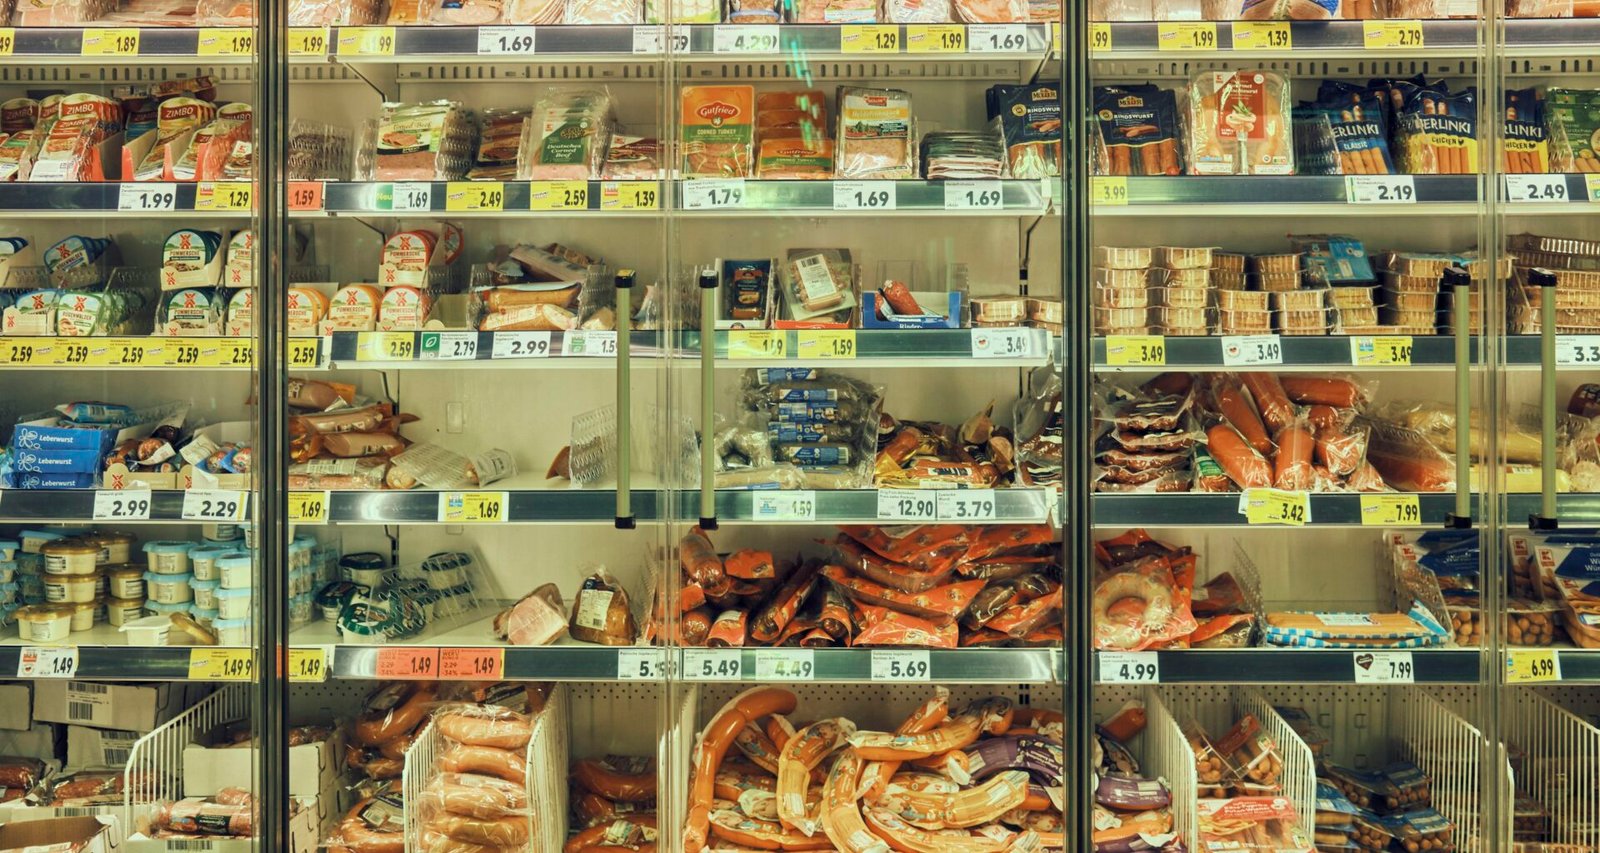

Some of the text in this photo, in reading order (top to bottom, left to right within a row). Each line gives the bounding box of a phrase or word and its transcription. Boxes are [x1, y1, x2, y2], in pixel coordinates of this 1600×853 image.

[117, 37, 136, 52] 1.89
[232, 37, 252, 52] 1.99
[303, 37, 323, 52] 1.99
[499, 36, 532, 51] 1.69
[876, 33, 896, 49] 1.29
[941, 33, 962, 49] 1.99
[990, 34, 1024, 50] 1.69
[1093, 31, 1108, 47] .99
[1193, 31, 1213, 47] 1.99
[1268, 31, 1288, 46] 1.39
[1398, 30, 1420, 46] 2.79
[66, 104, 94, 115] ZIMBO
[166, 107, 193, 118] ZIMBO
[699, 105, 736, 117] Gutfried
[1027, 106, 1060, 114] RINDSWUR
[1332, 123, 1380, 138] ERLINKI
[1431, 136, 1457, 145] CHICKEN
[229, 191, 249, 207] 1.29
[295, 190, 315, 207] 1.59
[480, 191, 501, 207] 2.49
[564, 190, 585, 206] 2.59
[635, 191, 655, 207] 1.39
[708, 188, 742, 205] 1.79
[855, 191, 889, 207] 1.69
[966, 191, 1000, 206] 1.69
[1104, 186, 1125, 200] 3.99
[1378, 185, 1412, 200] 2.19
[1527, 183, 1565, 199] 2.49
[140, 192, 174, 208] 1.99
[408, 192, 428, 208] 1.69
[11, 346, 32, 362] 2.59
[66, 346, 88, 362] 2.59
[122, 347, 144, 363] 2.59
[177, 347, 199, 363] 2.59
[293, 347, 315, 363] 2.59
[391, 341, 412, 357] 2.59
[453, 341, 475, 356] 2.79
[510, 340, 547, 355] 2.99
[602, 340, 617, 354] 1.5
[832, 339, 852, 355] 1.59
[1141, 346, 1162, 362] 3.49
[1258, 344, 1279, 360] 3.49
[1573, 346, 1600, 362] 3.3
[39, 433, 74, 444] Leberwurst
[38, 456, 72, 466] Leberwurst
[41, 479, 76, 488] Leberwurst
[112, 500, 148, 516] 2.99
[200, 500, 237, 517] 2.29
[302, 501, 321, 517] 1.69
[479, 501, 499, 518] 1.69
[792, 500, 812, 516] 1.59
[898, 499, 933, 516] 12.90
[956, 501, 993, 517] 3.79
[1282, 503, 1304, 522] 3.42
[1396, 504, 1418, 520] 7.99
[53, 657, 73, 674] 1.49
[224, 659, 243, 676] 1.49
[300, 659, 320, 676] 1.49
[411, 656, 431, 673] 1.49
[474, 656, 494, 673] 1.49
[702, 660, 739, 676] 5.49
[775, 661, 813, 677] 4.49
[890, 661, 927, 677] 5.69
[1119, 663, 1157, 680] 4.99
[1389, 661, 1411, 678] 7.99
[1531, 659, 1554, 676] 6.99
